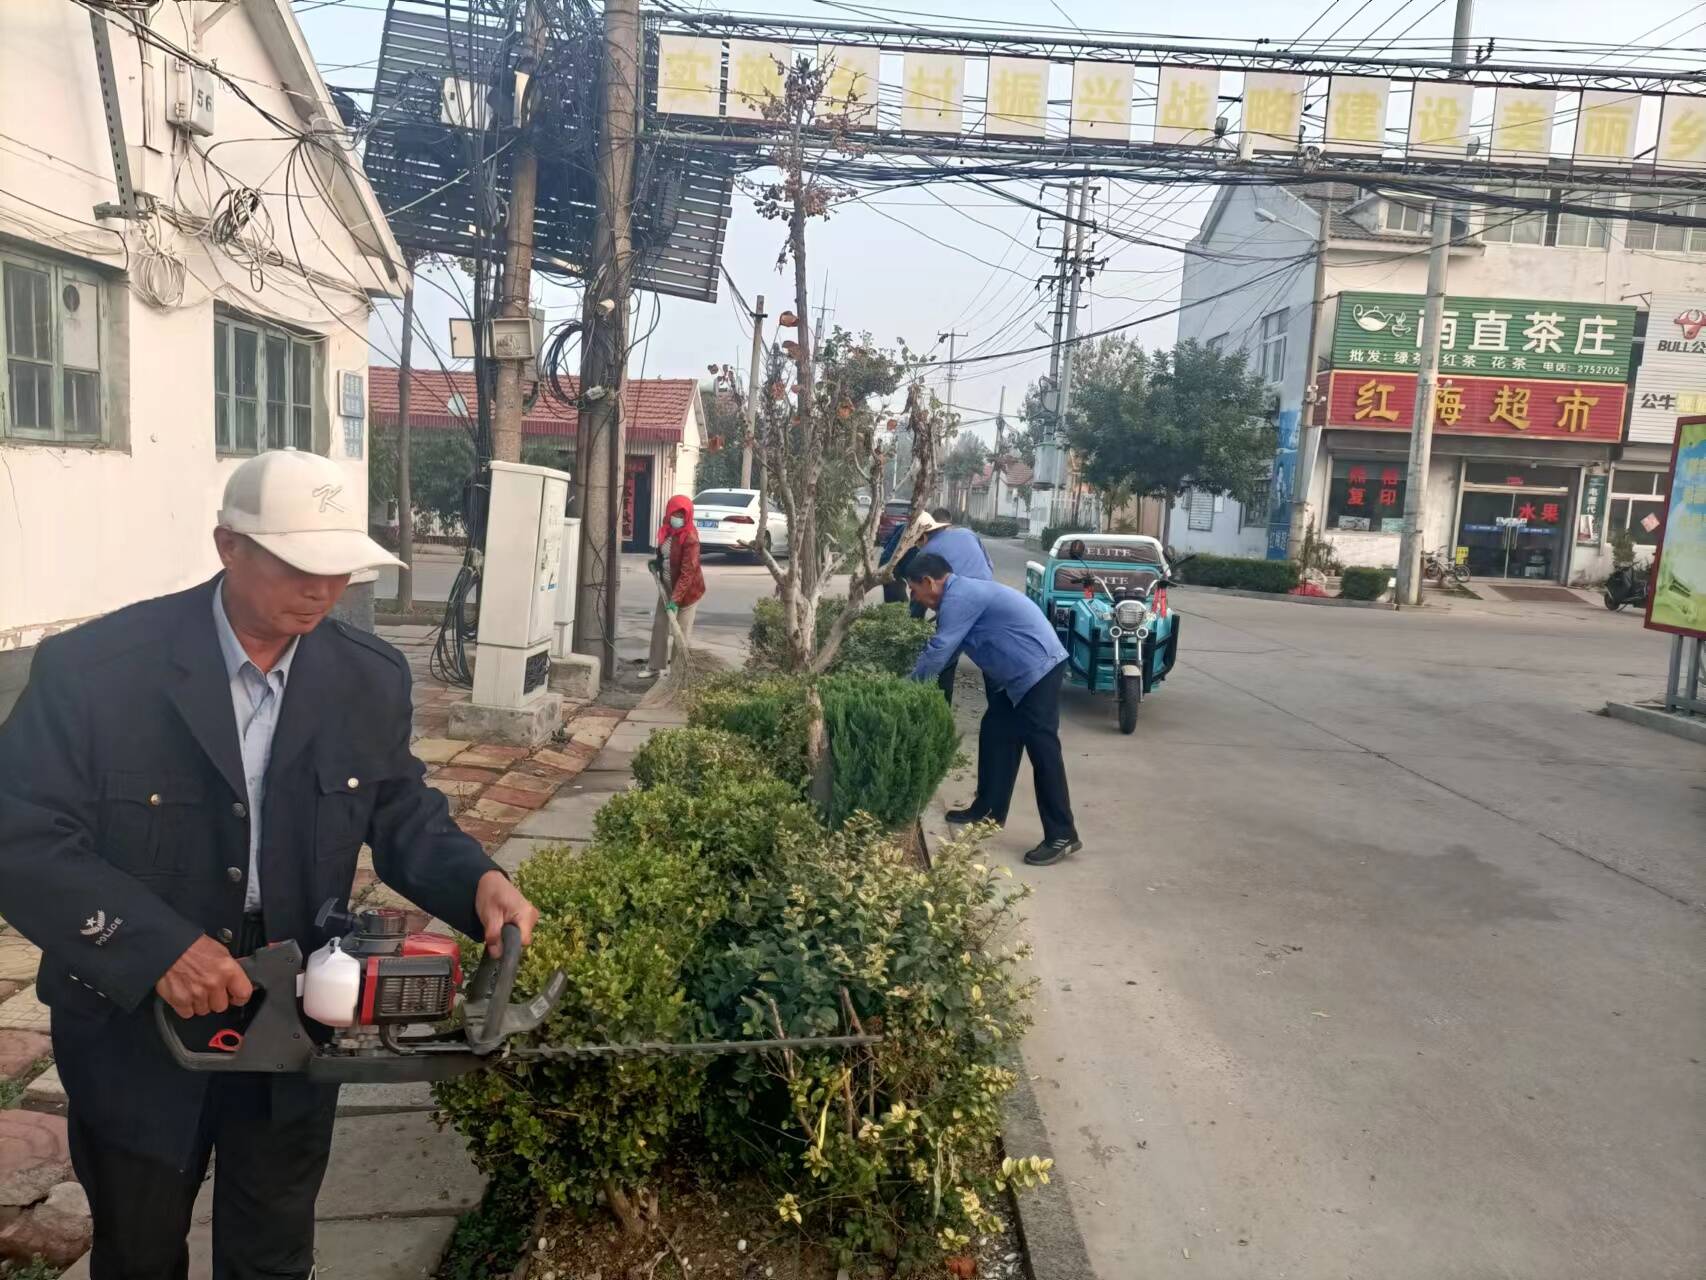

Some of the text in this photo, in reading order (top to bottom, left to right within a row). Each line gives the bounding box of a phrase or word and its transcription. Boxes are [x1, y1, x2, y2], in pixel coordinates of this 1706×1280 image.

[197, 89, 212, 112] 56
[1442, 353, 1477, 368] 红茶
[1491, 356, 1527, 370] 花茶
[1577, 365, 1620, 375] 2752702
[1641, 392, 1676, 410] 公牛
[1519, 503, 1560, 523] 水果
[1087, 547, 1131, 557] ELITE
[95, 917, 124, 946] POLICE
